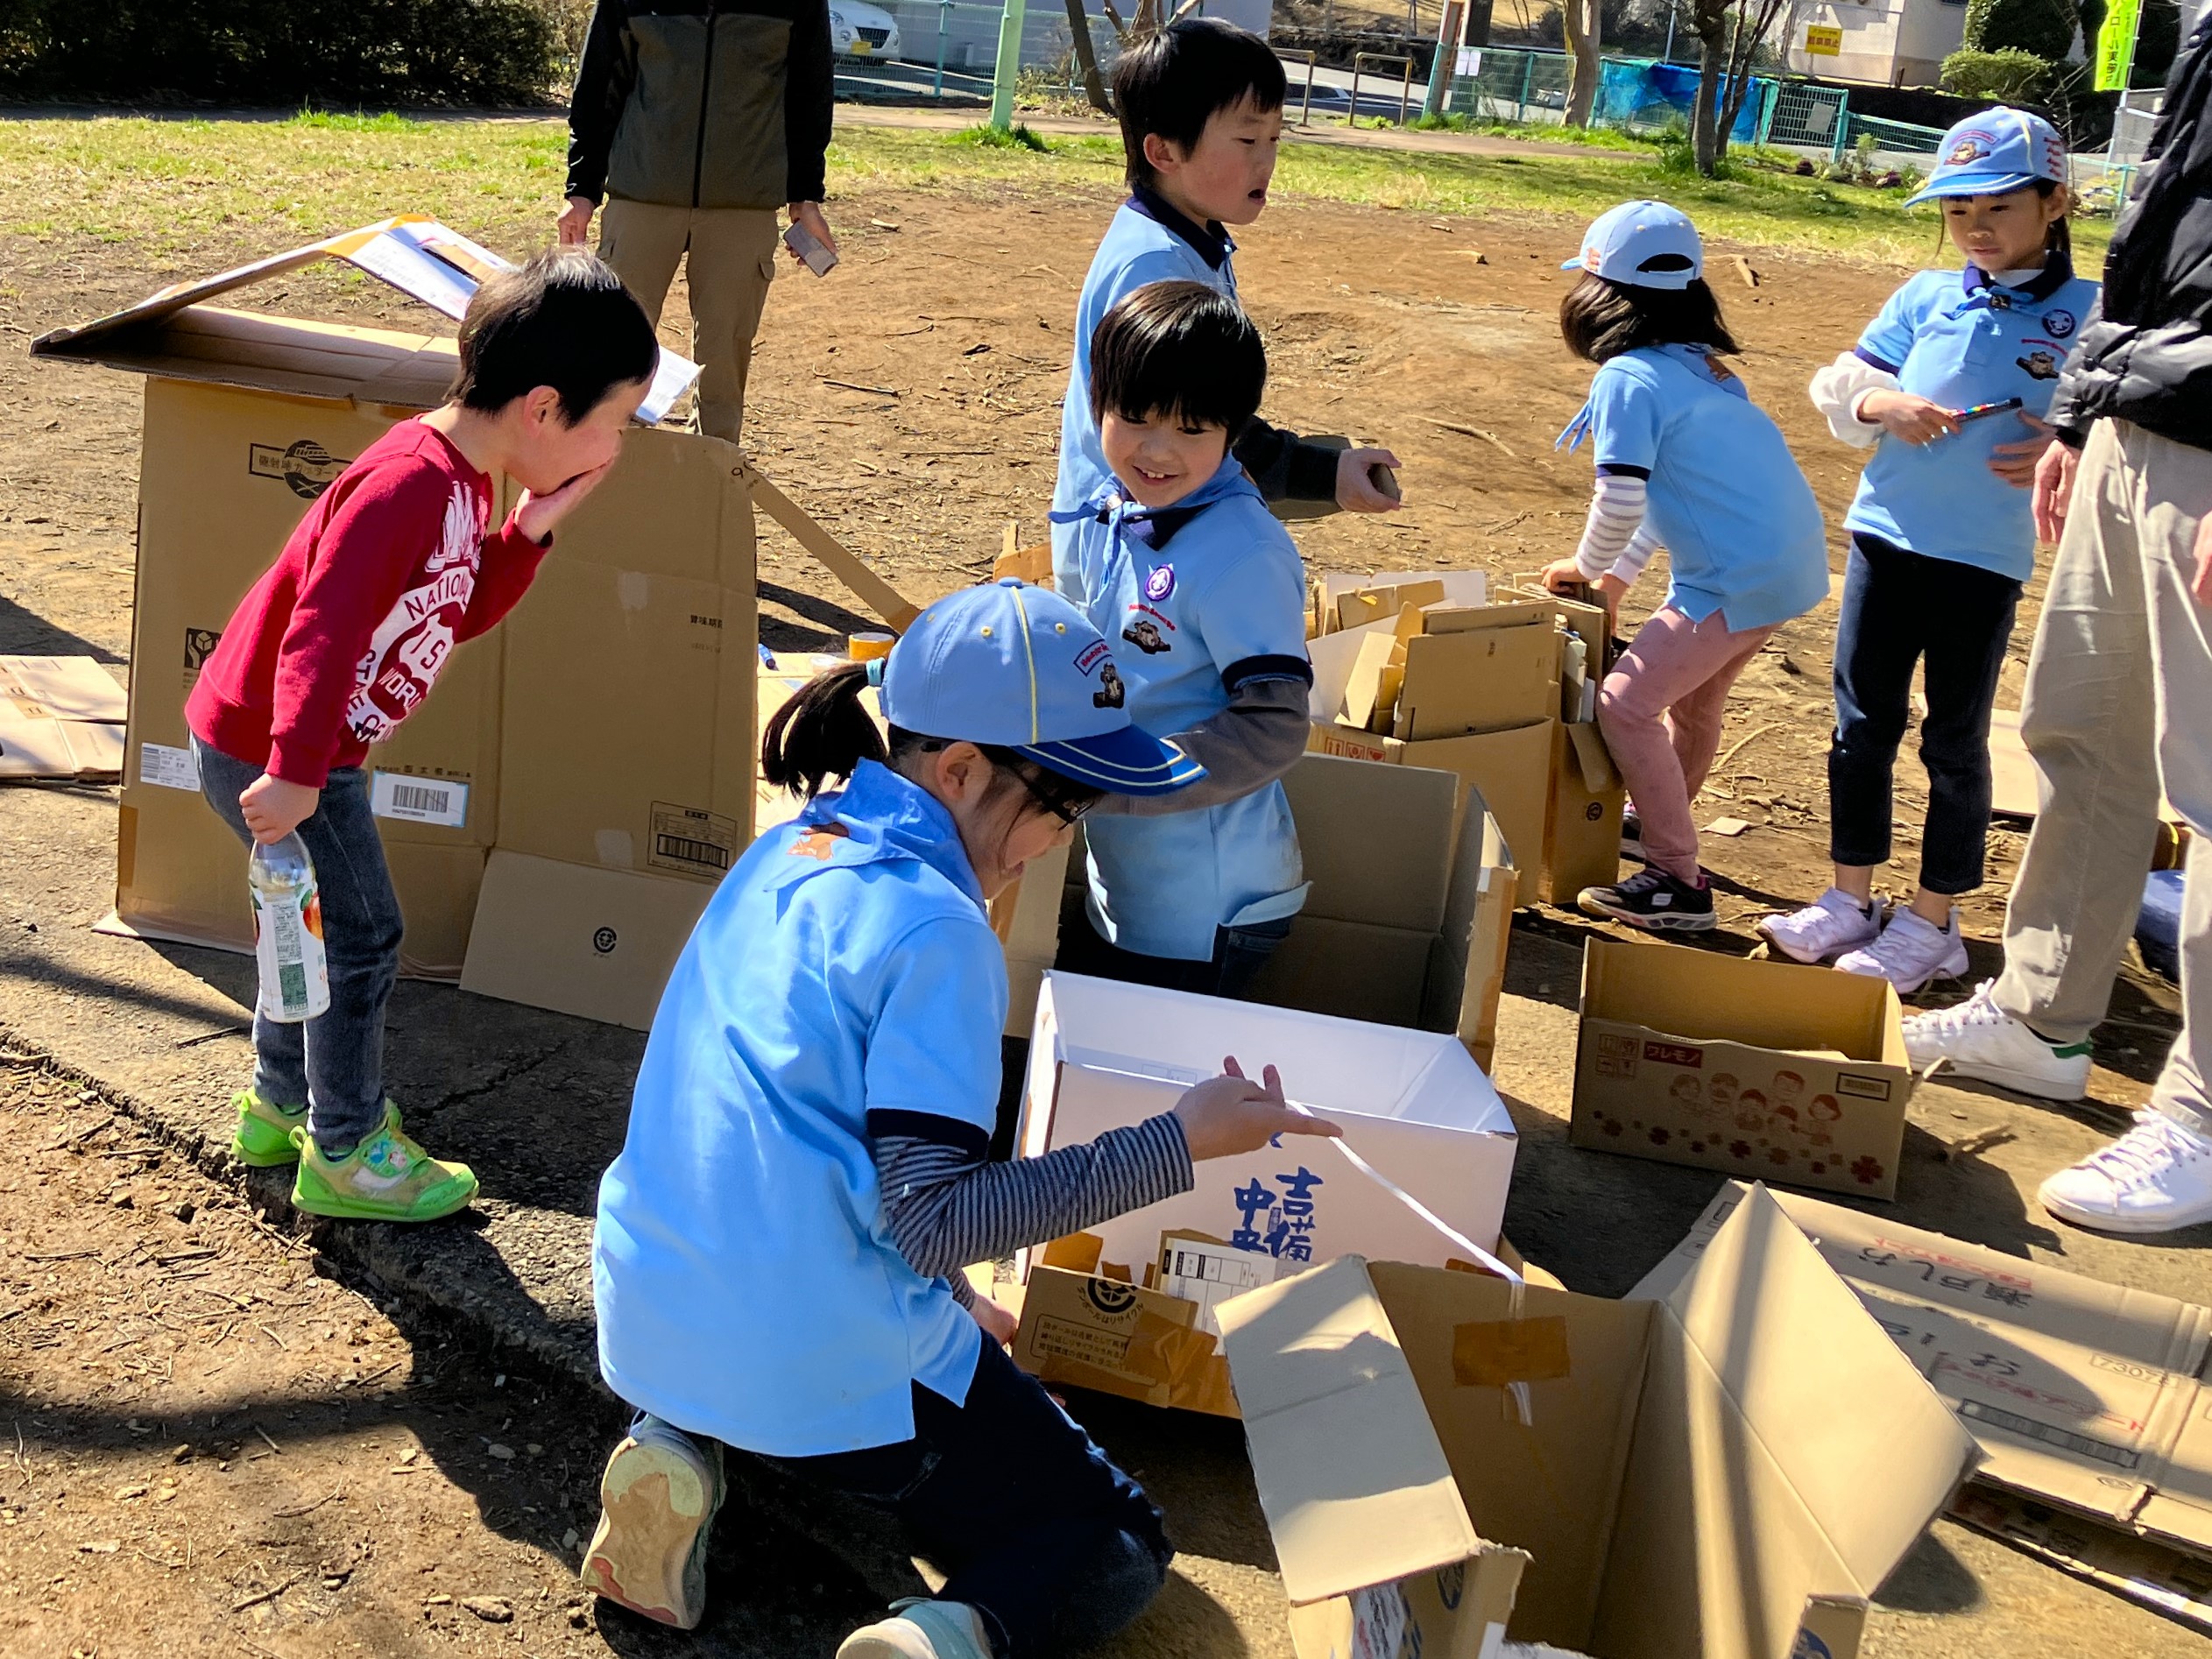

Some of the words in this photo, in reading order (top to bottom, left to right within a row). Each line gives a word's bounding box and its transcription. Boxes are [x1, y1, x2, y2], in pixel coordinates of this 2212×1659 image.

[1647, 1045, 1701, 1064] ワレモノ
[1263, 1166, 1324, 1262] 吉備
